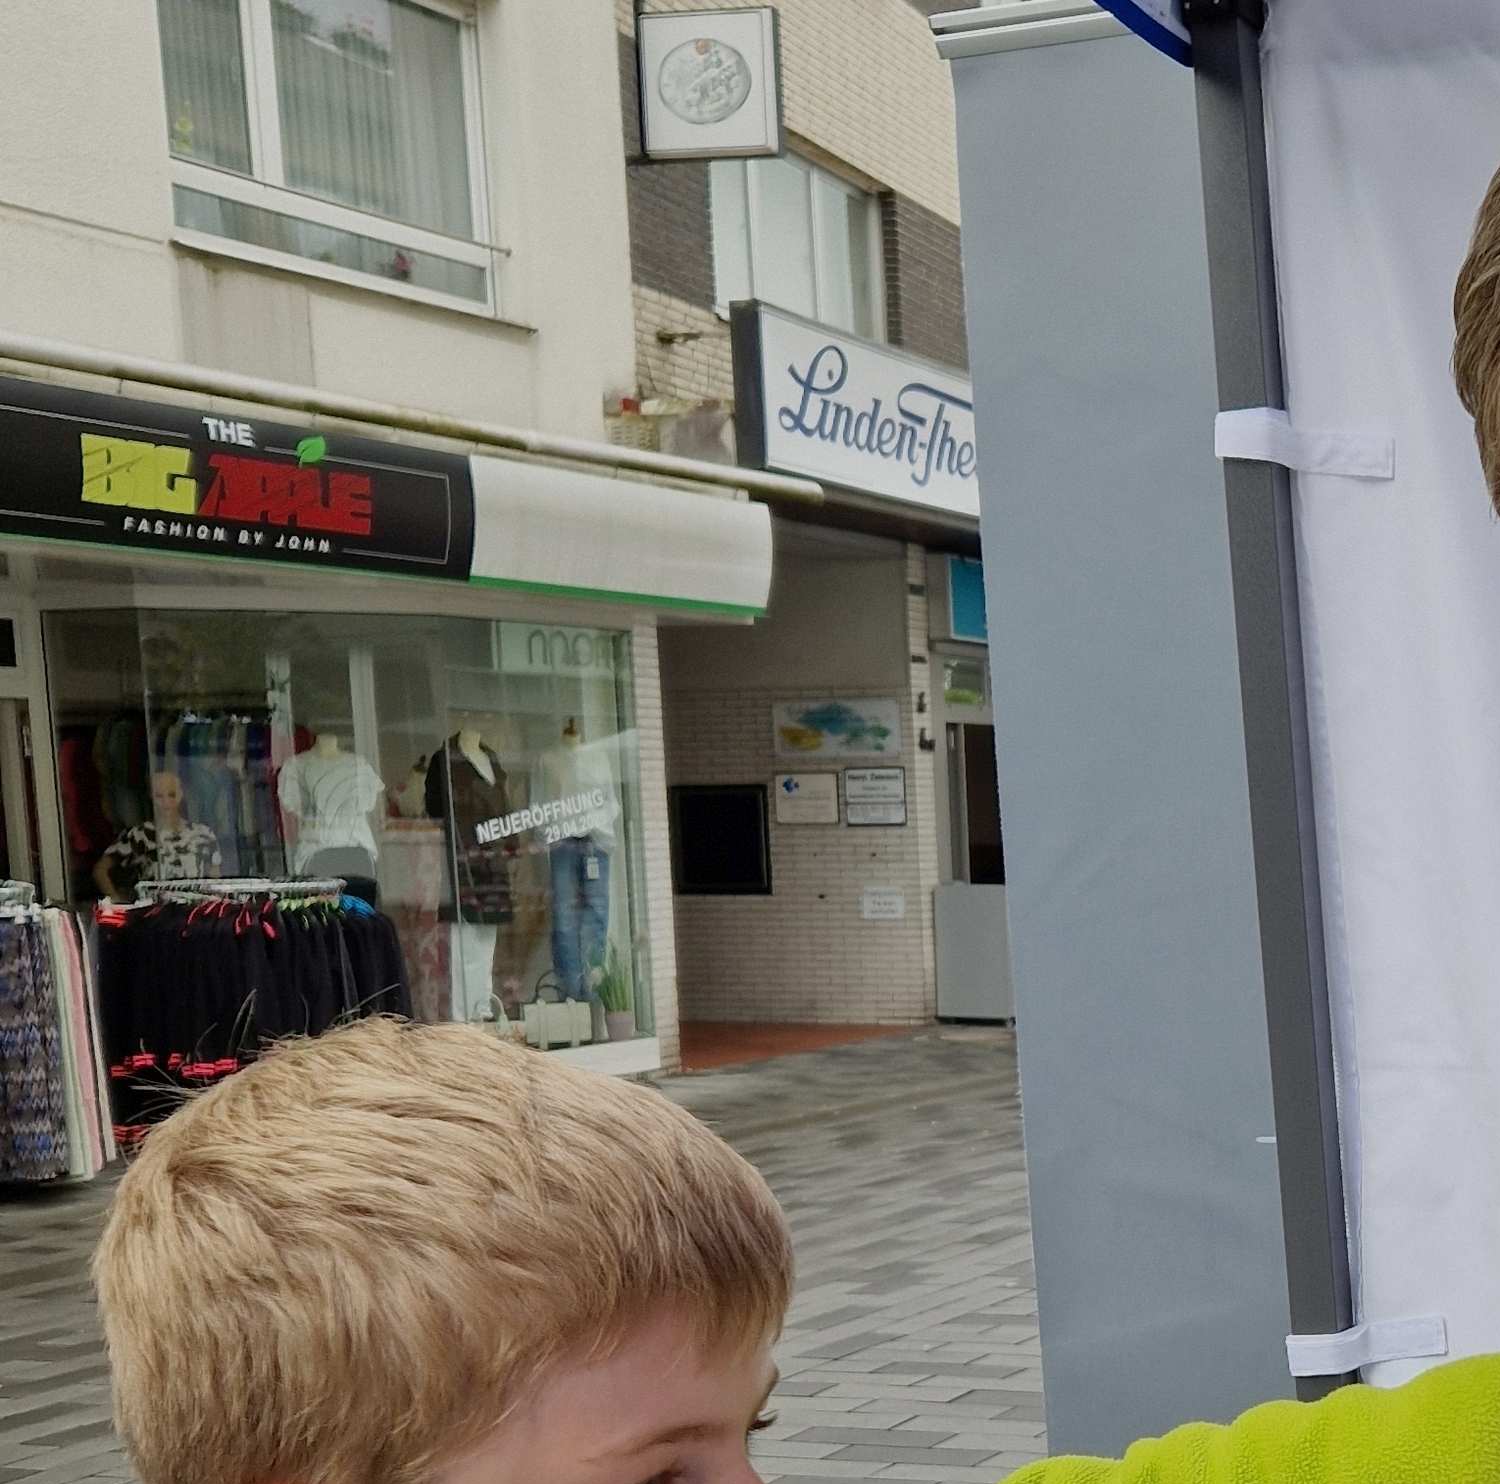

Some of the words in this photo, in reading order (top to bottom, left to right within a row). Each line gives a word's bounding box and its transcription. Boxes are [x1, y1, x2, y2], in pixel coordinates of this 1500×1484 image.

[201, 416, 257, 448] THE
[778, 345, 977, 486] Linden-The
[80, 433, 198, 515] BIG
[198, 453, 372, 536] APPLE
[123, 516, 227, 543] FASHION
[238, 529, 265, 546] BY
[274, 535, 332, 553] JOHN
[475, 788, 605, 845] NEUERÖFFNUNG
